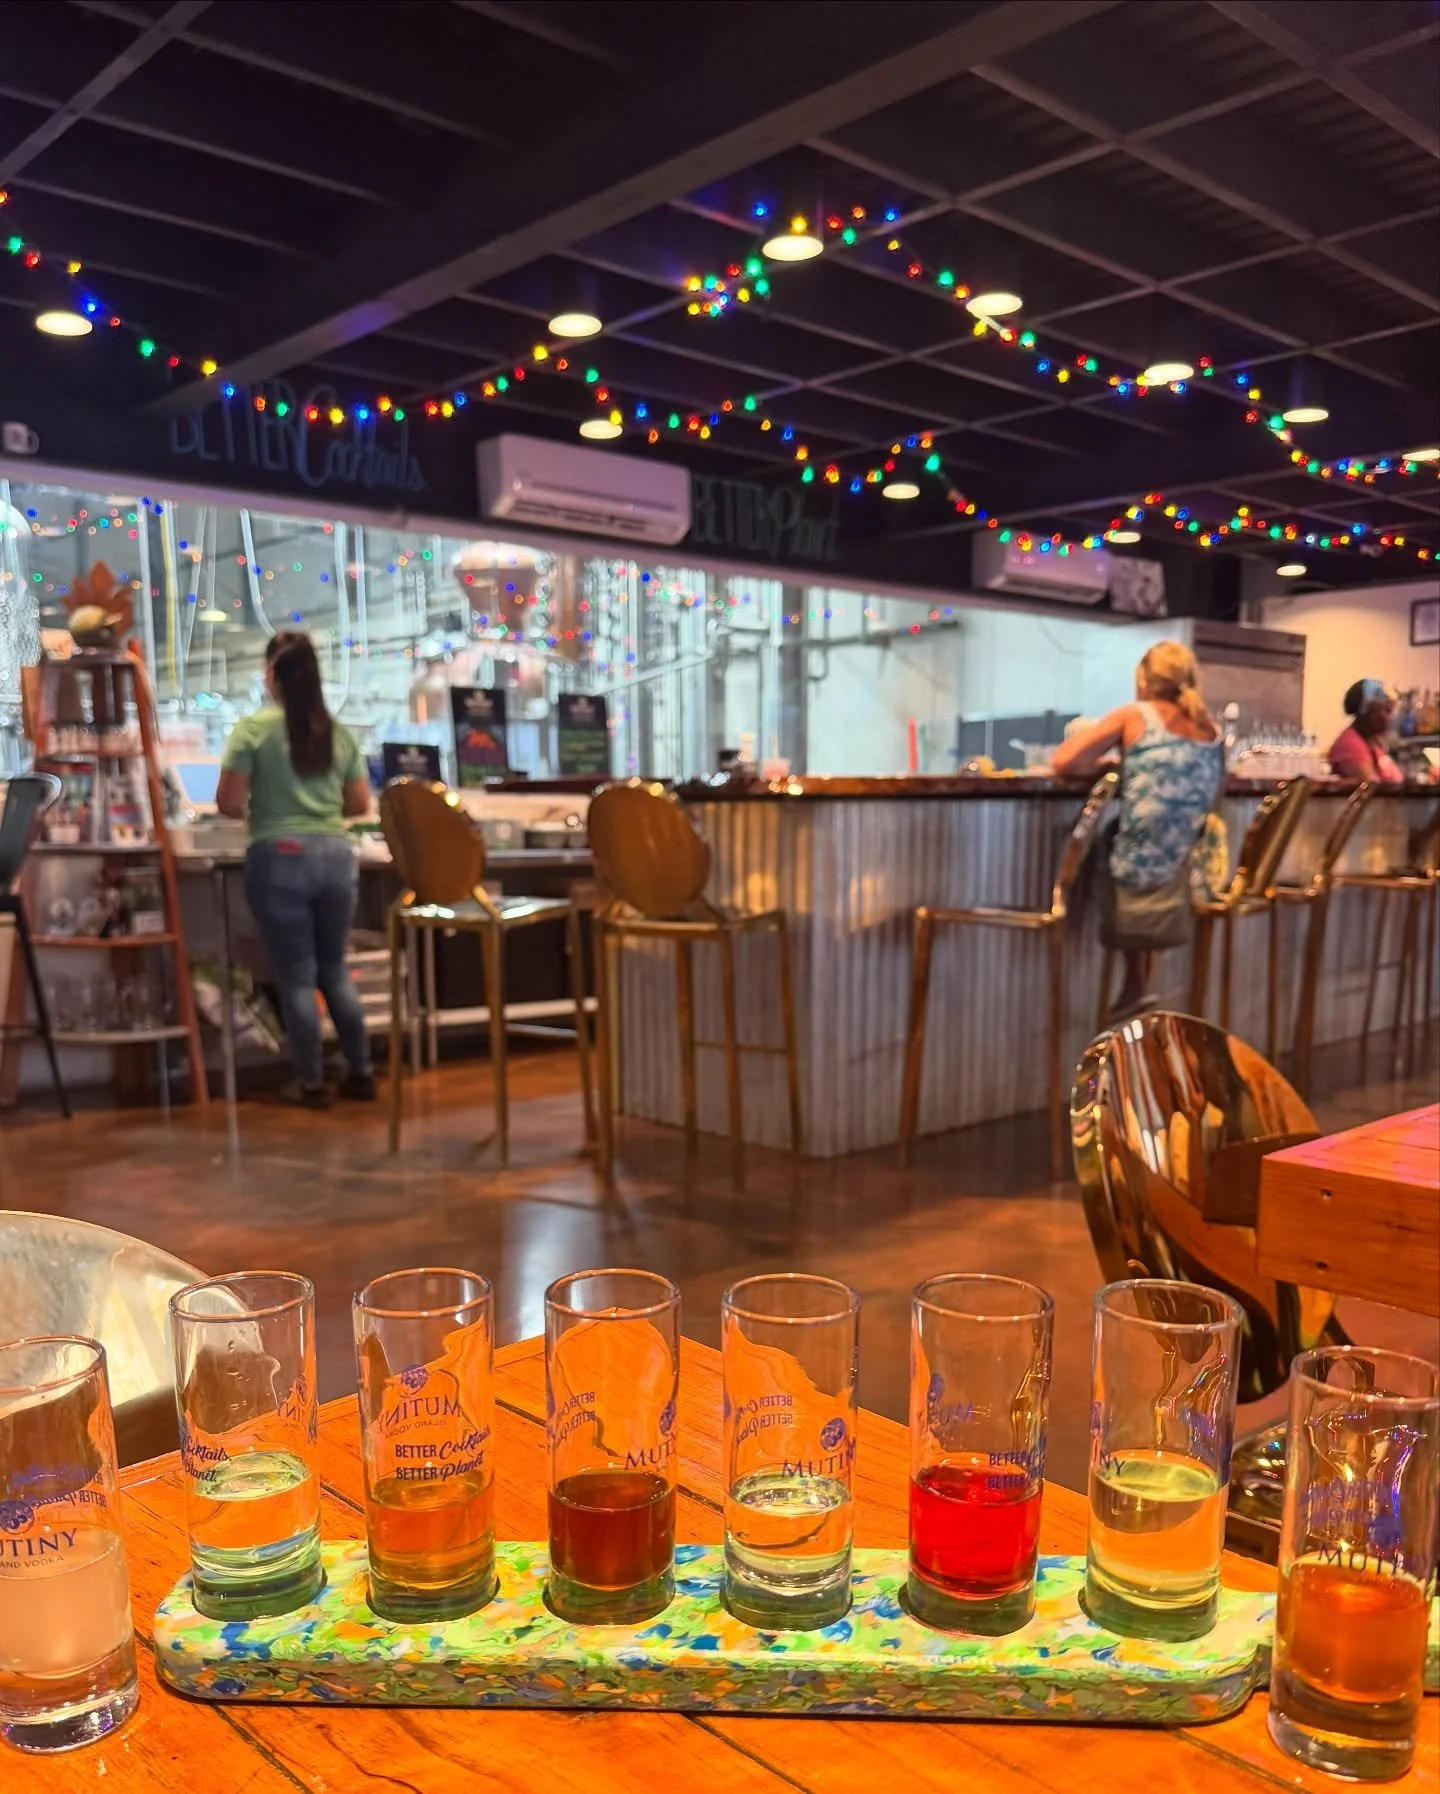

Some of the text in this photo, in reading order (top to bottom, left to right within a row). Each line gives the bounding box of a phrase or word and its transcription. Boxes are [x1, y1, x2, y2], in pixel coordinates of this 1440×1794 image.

[395, 1445, 437, 1459] BETTER
[396, 1466, 437, 1481] BETTER
[0, 1527, 77, 1557] TINY
